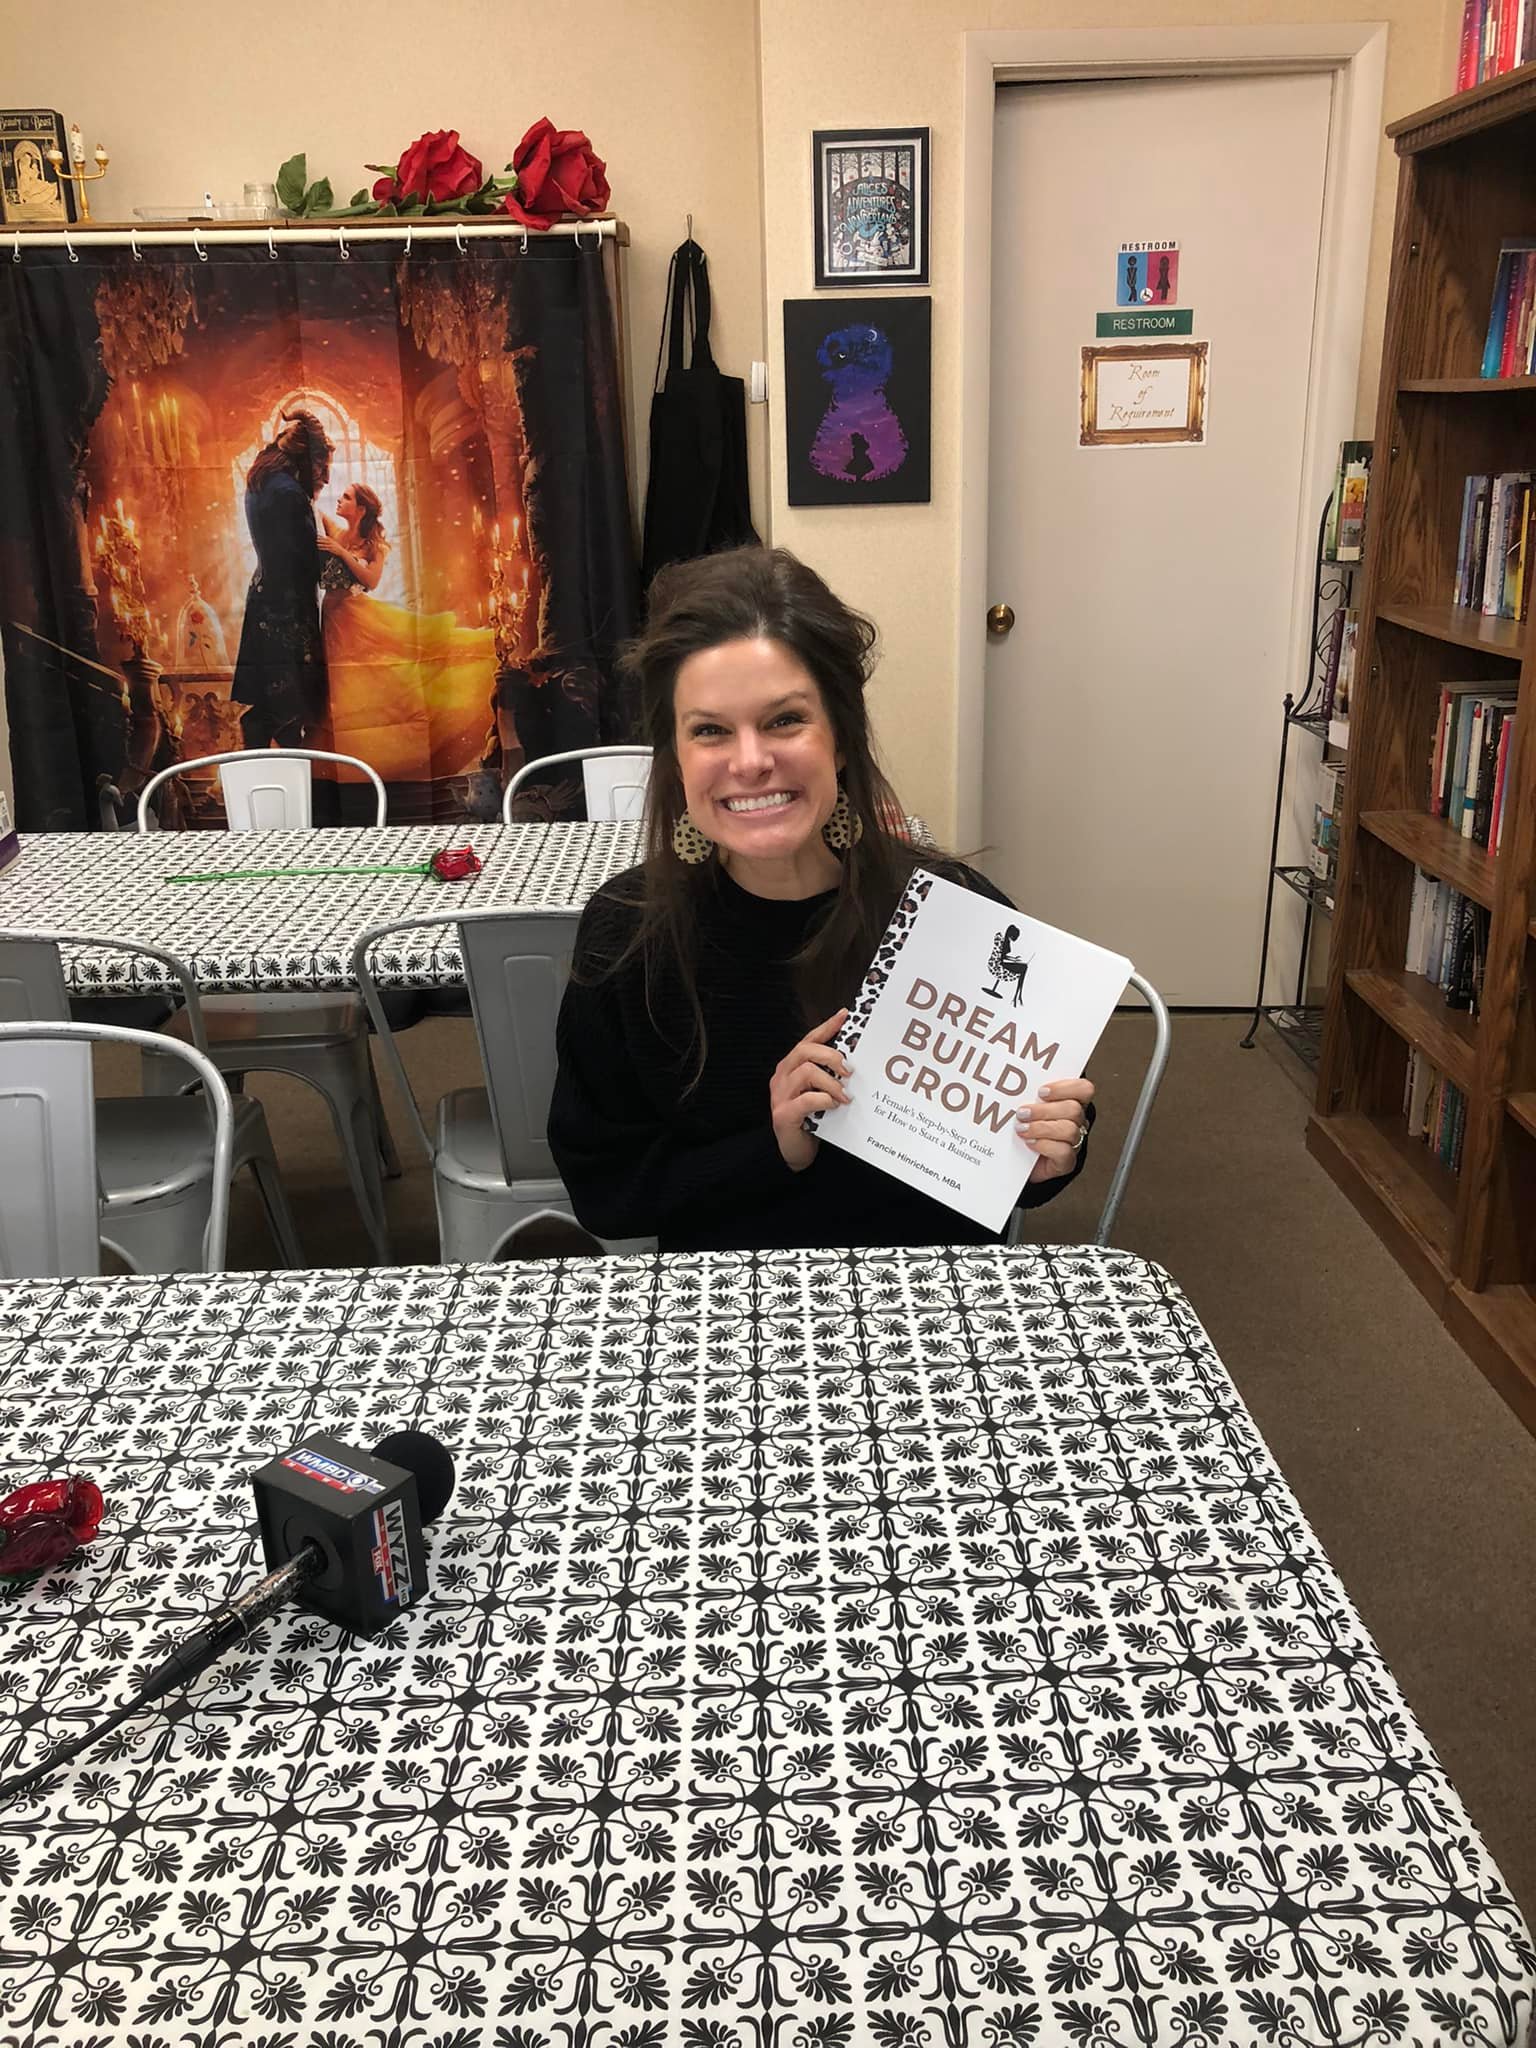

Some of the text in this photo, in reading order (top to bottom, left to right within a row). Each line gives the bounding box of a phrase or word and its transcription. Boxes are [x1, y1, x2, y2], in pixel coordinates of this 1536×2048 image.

[1122, 241, 1176, 252] RESTROOM
[1113, 317, 1175, 330] RESTROOM
[1128, 363, 1160, 381] Room
[1133, 385, 1153, 405] of
[1110, 404, 1175, 427] Requirement
[906, 977, 1060, 1071] DREAM
[901, 1018, 1028, 1097] BUILD
[885, 1054, 1017, 1134] GROW
[872, 1090, 995, 1159] A Female's Step-by-Step Guide
[873, 1104, 981, 1167] for How to Start a Business
[866, 1135, 961, 1191] Francie Hinrichsen, MBA
[296, 1452, 349, 1480] WMBD
[386, 1505, 410, 1590] WYZZ
